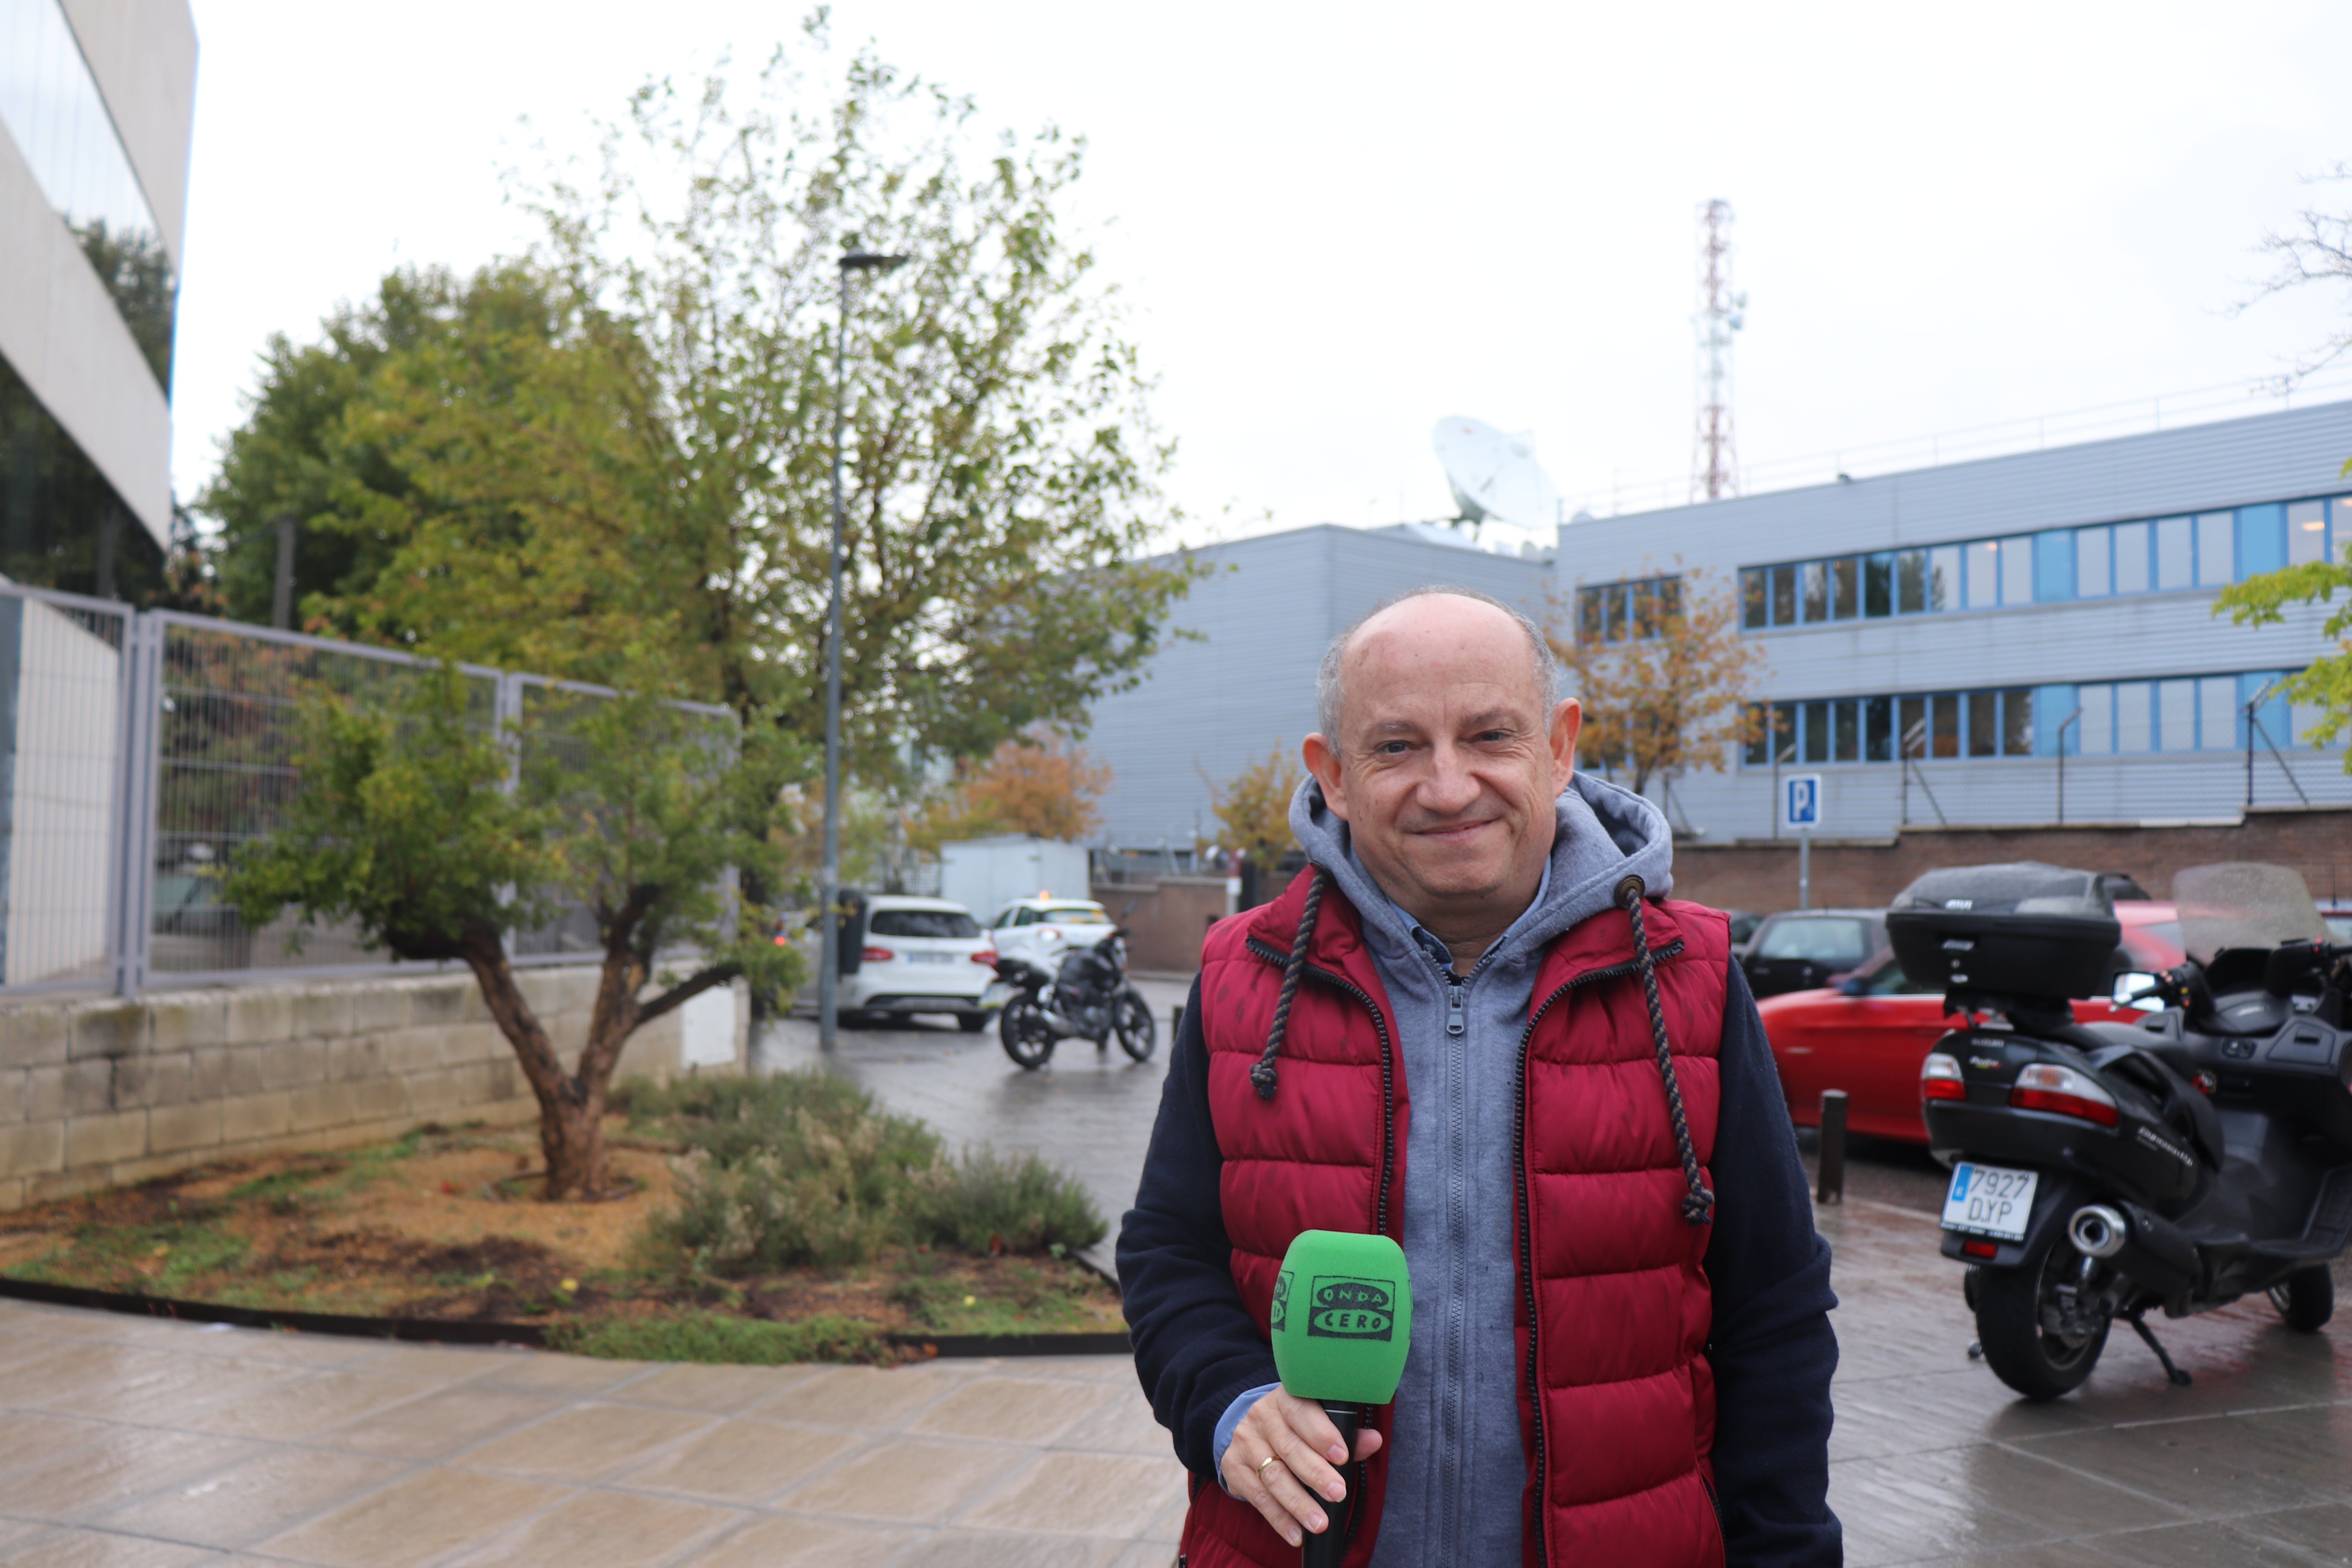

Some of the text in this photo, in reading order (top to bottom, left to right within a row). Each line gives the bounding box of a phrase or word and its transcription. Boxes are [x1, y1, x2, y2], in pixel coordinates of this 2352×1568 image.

[1793, 782, 1810, 820] P
[1971, 1168, 2029, 1200] 7927
[1968, 1197, 2013, 1225] DYP
[1323, 1289, 1383, 1302] ONDA
[1325, 1313, 1382, 1329] CERO
